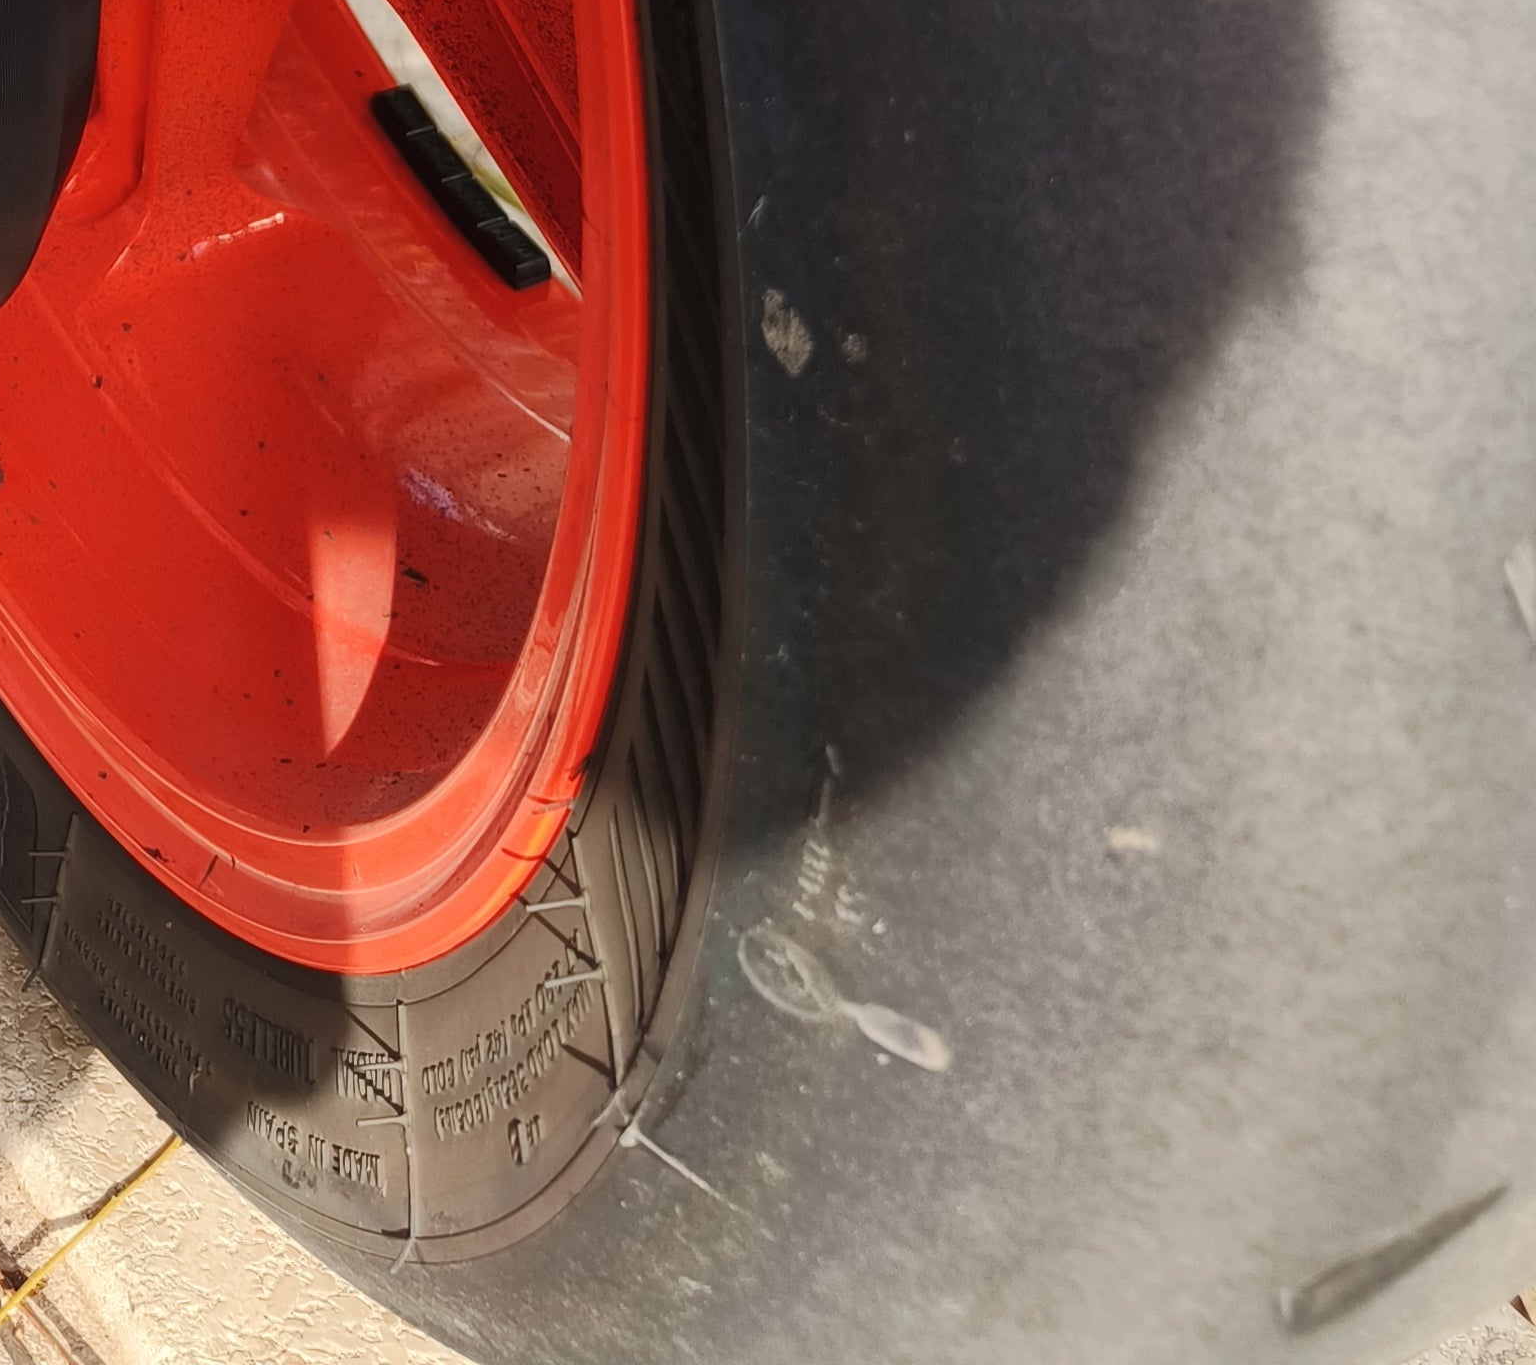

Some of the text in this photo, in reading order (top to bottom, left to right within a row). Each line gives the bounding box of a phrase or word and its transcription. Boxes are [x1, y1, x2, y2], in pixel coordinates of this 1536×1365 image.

[421, 1057, 459, 1096] COLD
[526, 1019, 567, 1079] LOAD
[246, 1101, 386, 1190] MADE IN SPAIN
